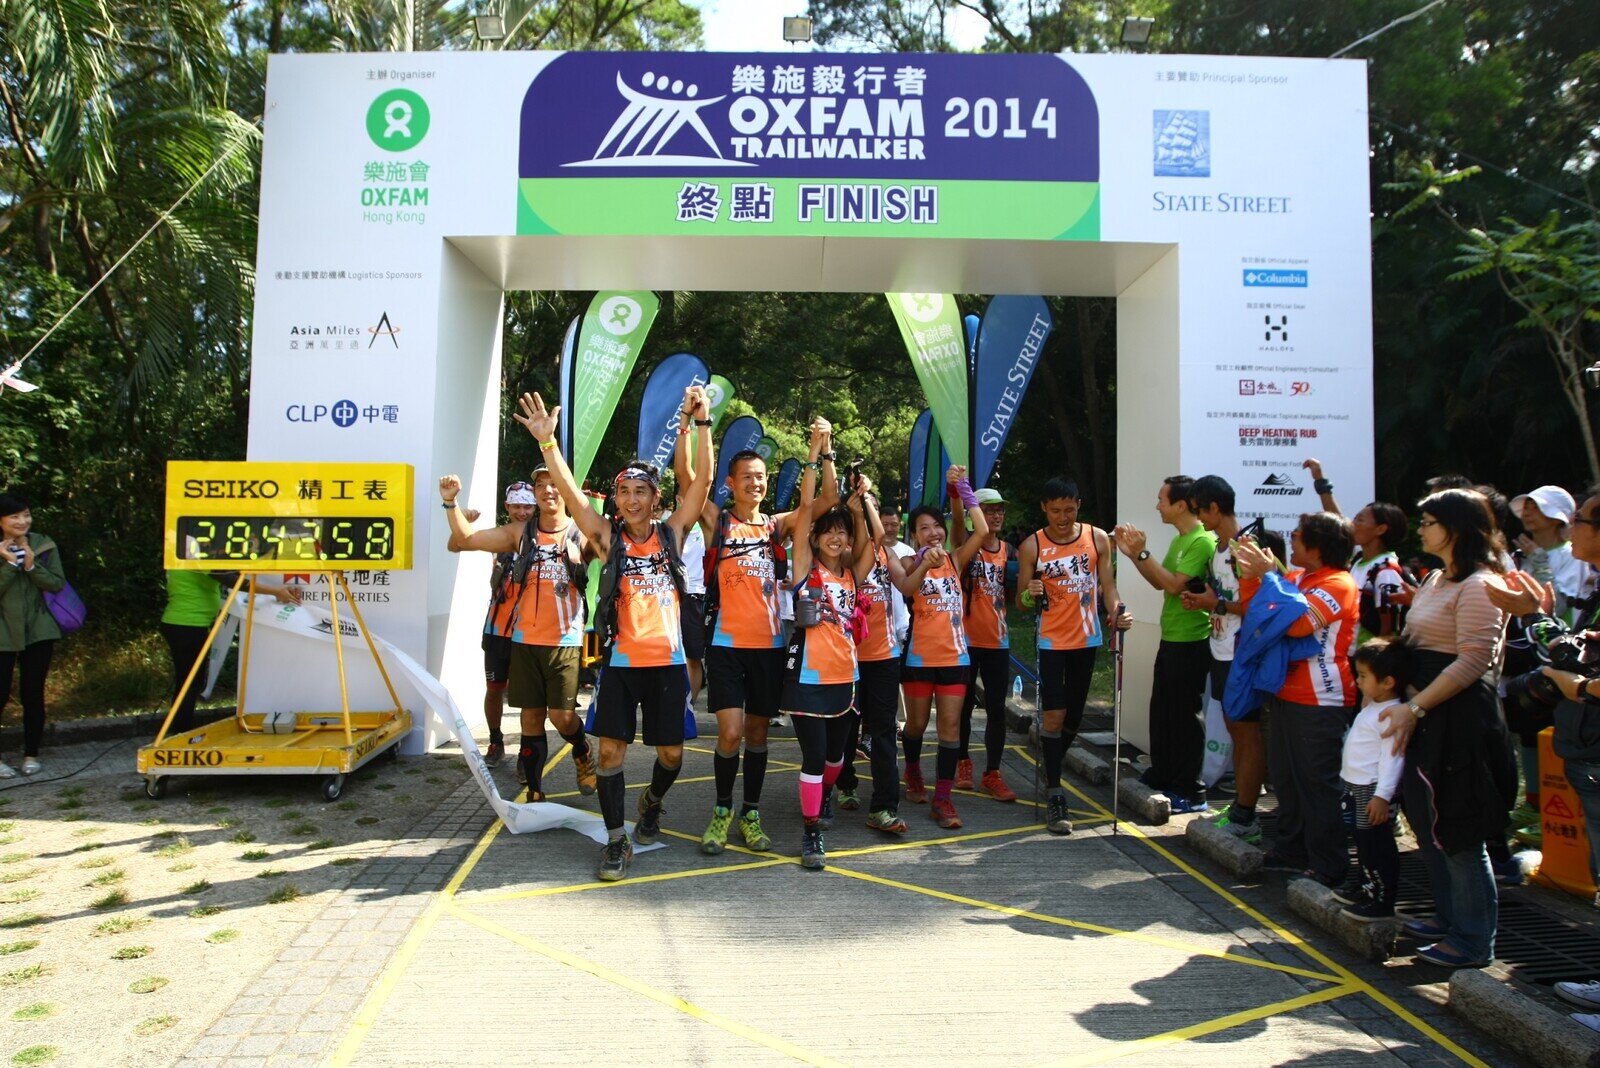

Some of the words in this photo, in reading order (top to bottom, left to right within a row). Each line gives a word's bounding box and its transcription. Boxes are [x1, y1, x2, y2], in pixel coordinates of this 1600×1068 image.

[390, 69, 436, 82] Organiser
[731, 65, 927, 95] 樂施毅行者
[1202, 72, 1246, 84] Principal
[1249, 74, 1288, 84] Sponsor
[728, 96, 926, 138] OXFAM
[944, 97, 1057, 139] 2014
[731, 137, 926, 160] TRAILWALKER
[363, 160, 430, 183] 樂施會
[361, 187, 429, 206] OXFAM
[675, 182, 776, 223] 終點
[797, 184, 939, 223] FINISH
[1153, 191, 1213, 212] STATE
[362, 211, 393, 225] Hong
[396, 211, 425, 225] Kong
[348, 271, 384, 281] Logistics
[386, 271, 422, 280] Sponsors
[1257, 272, 1306, 285] Columbia
[290, 325, 320, 335] Asia
[326, 325, 360, 335] Miles
[1007, 312, 1050, 389] STREET
[286, 405, 327, 422] CLP
[363, 405, 399, 423] 中電
[981, 386, 1019, 452] STATE
[1239, 428, 1261, 438] DEEP
[1262, 428, 1298, 438] HEATING
[1300, 429, 1318, 438] RUB
[184, 480, 279, 499] SEIKO
[298, 479, 388, 500] 精工表
[1253, 487, 1304, 495] montrail
[747, 569, 775, 579] DRAGO
[356, 733, 378, 760] SEIKO
[154, 750, 223, 766] SEIKO
